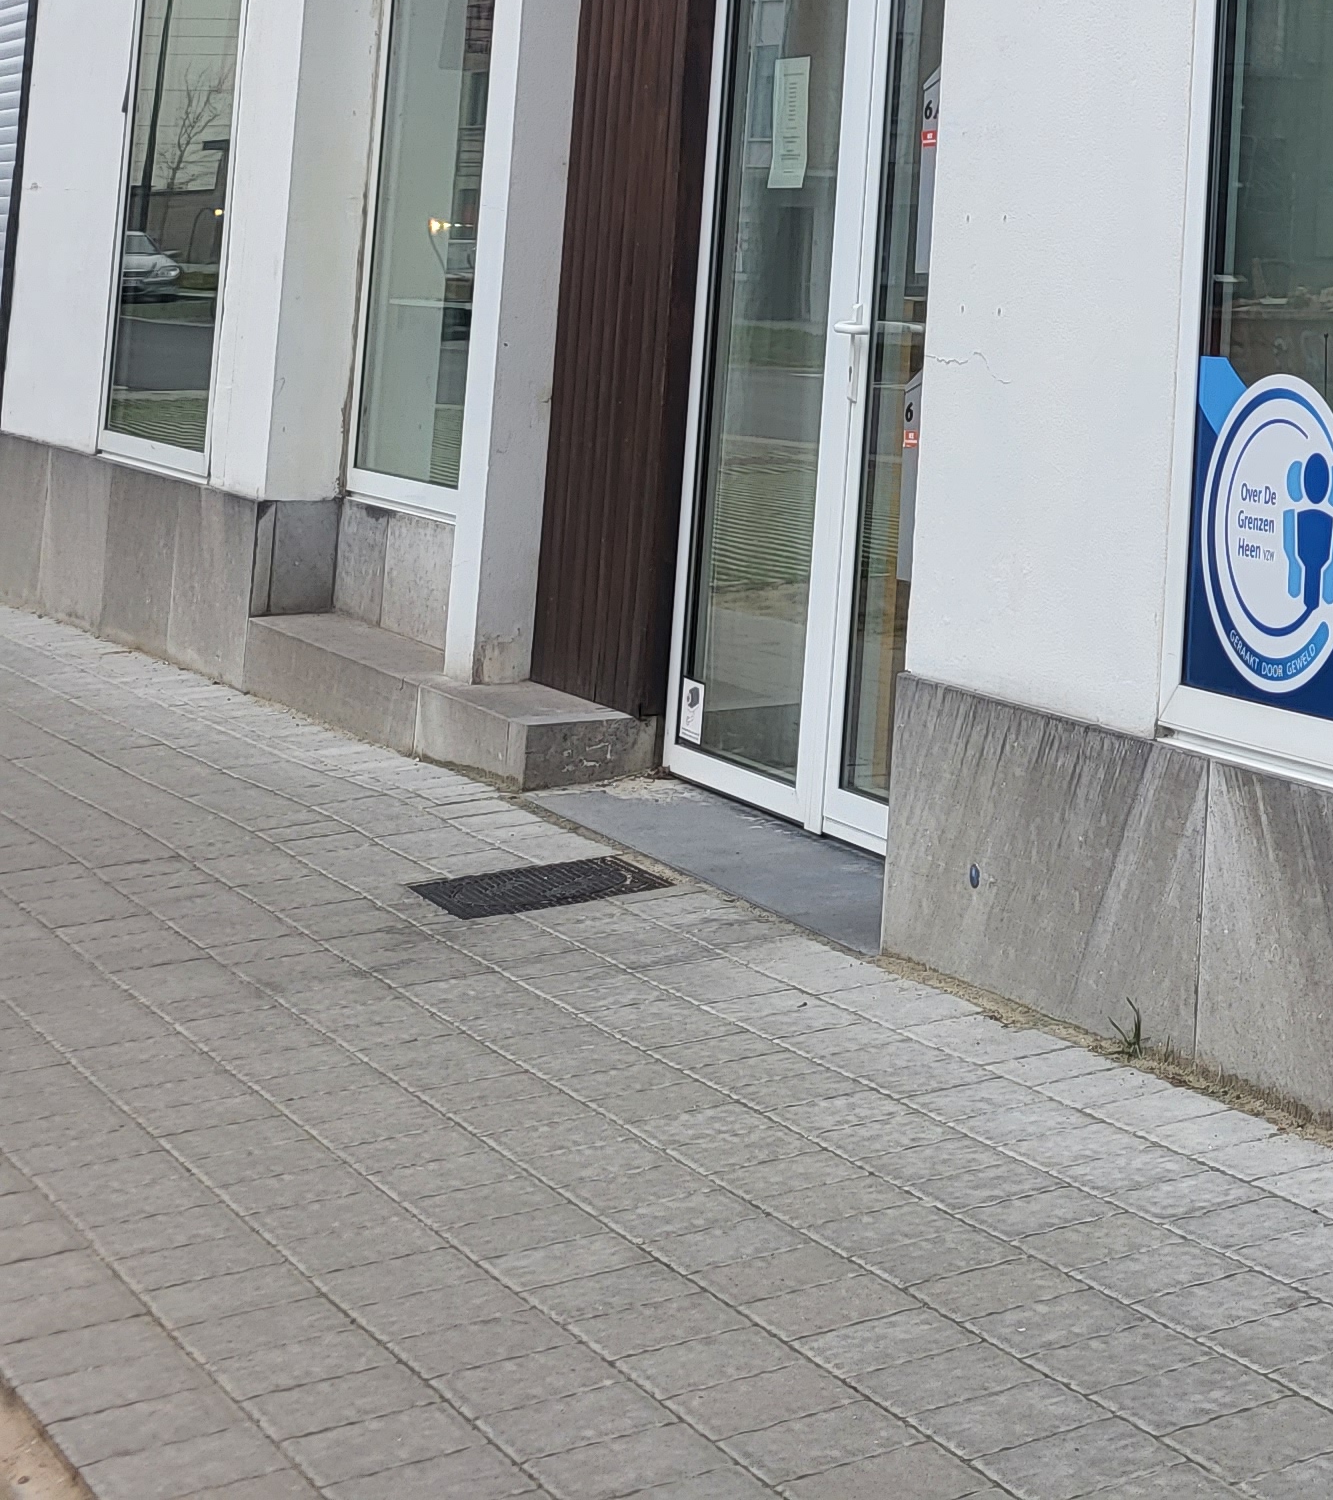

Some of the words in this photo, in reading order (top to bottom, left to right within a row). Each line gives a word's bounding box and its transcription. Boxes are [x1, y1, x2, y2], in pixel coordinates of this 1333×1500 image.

[905, 402, 913, 422] 6
[1241, 483, 1262, 504] Over
[1264, 486, 1276, 505] De
[1238, 510, 1274, 534] Grenzen
[1238, 538, 1261, 559] Heen
[1263, 549, 1274, 561] VZW
[1230, 630, 1259, 670] GERAAKT
[1262, 662, 1283, 677] DOOR
[1287, 644, 1315, 675] GEWELD
